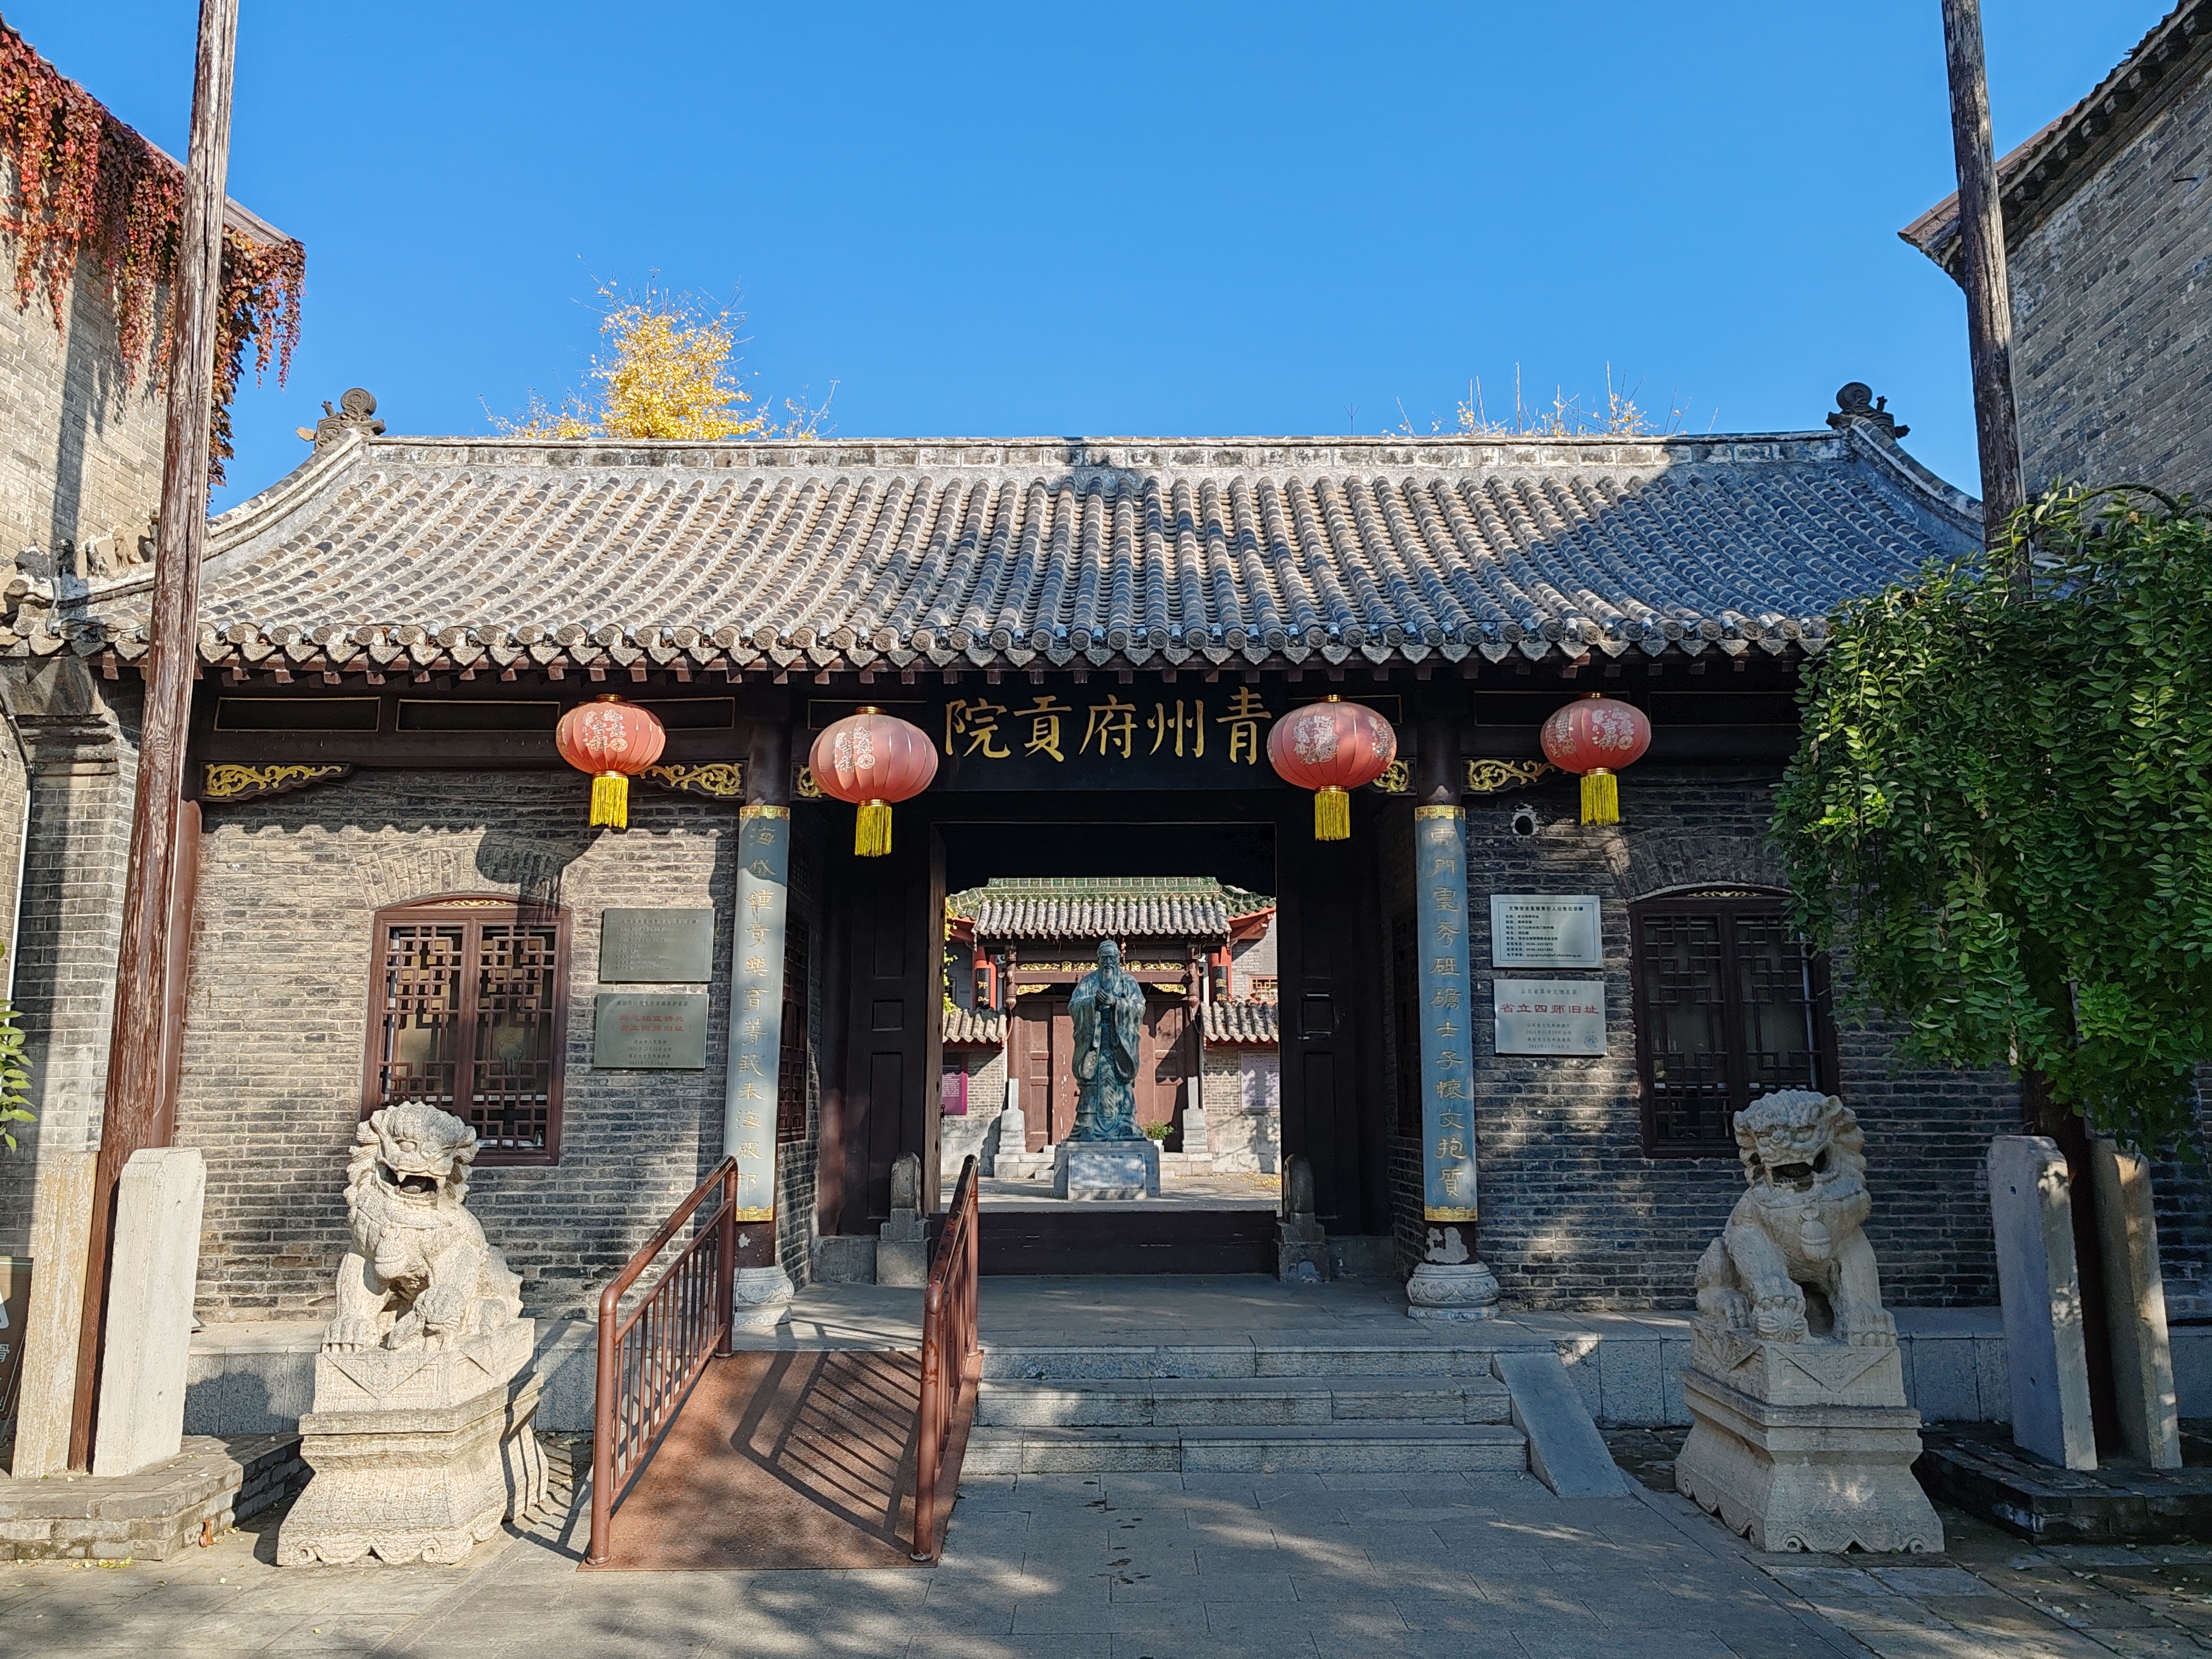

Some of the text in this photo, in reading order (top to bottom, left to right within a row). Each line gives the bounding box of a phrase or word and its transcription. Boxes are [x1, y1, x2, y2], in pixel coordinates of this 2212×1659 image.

[944, 686, 1271, 765] 青州府貢院
[1500, 1003, 1600, 1014] 省立四师旧址
